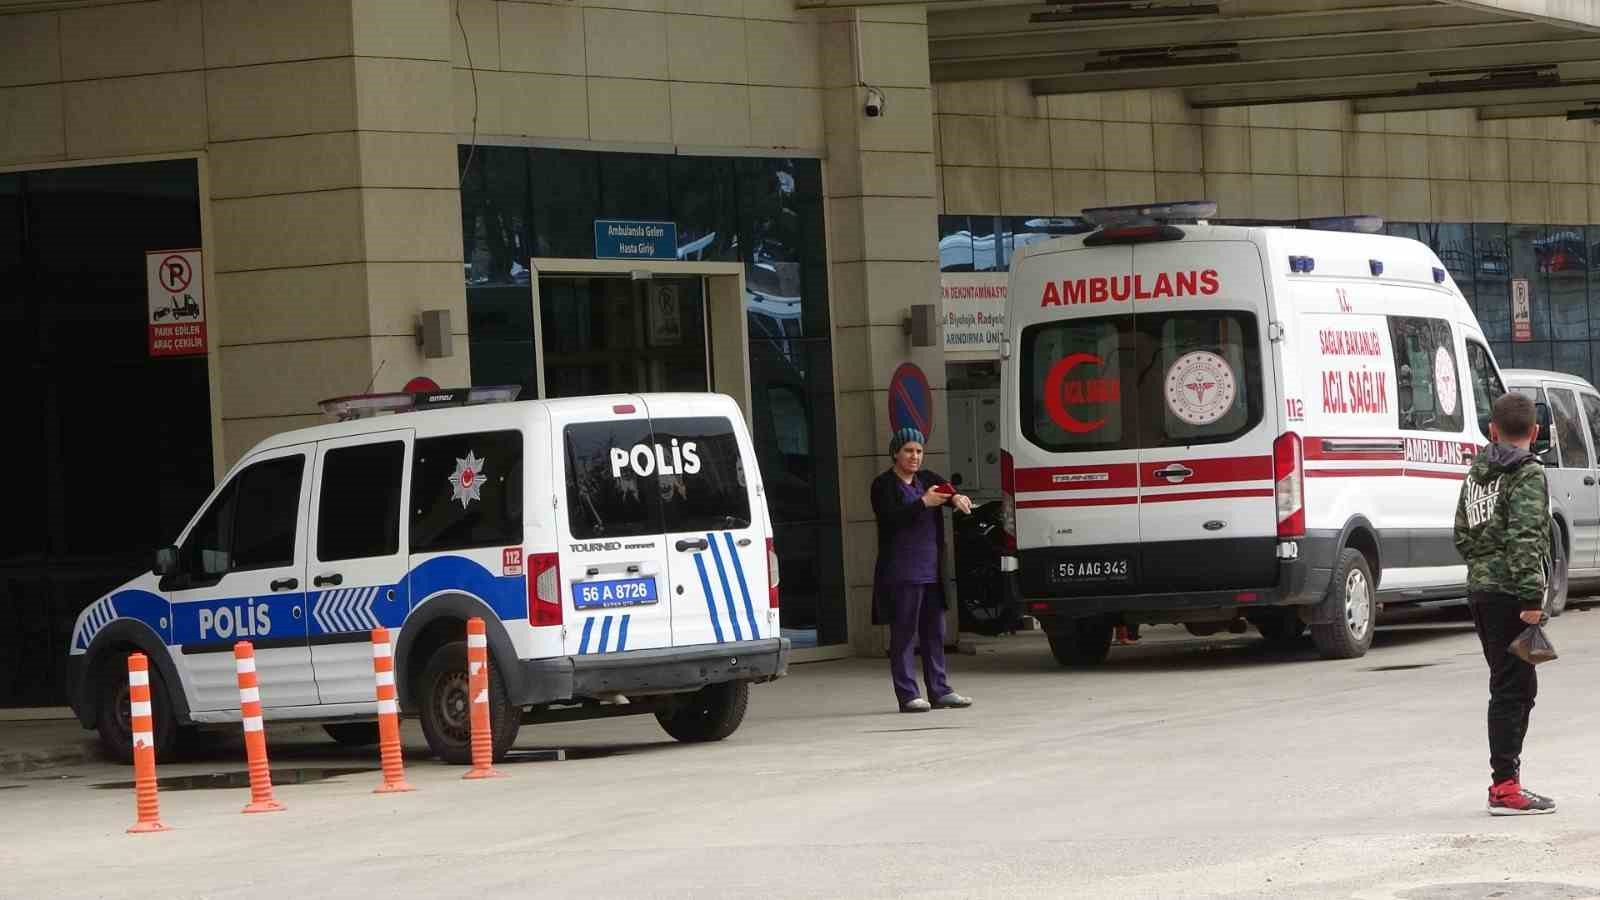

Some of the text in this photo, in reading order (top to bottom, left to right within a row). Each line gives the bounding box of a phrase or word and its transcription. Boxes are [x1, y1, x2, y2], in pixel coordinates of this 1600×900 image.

[645, 225, 664, 237] Gelen
[619, 242, 637, 254] Hasta
[1041, 269, 1219, 307] AMBULANS
[1322, 364, 1388, 414] ACİL SAĞLIK
[1286, 398, 1304, 417] 112
[610, 438, 701, 478] POLİS
[1407, 438, 1463, 465] AMBULANS
[569, 541, 622, 553] TOURNEO
[506, 550, 521, 565] 112
[1059, 561, 1128, 577] 56 AAG 343
[582, 583, 648, 602] 56 A 8726
[198, 598, 272, 640] POLİS
